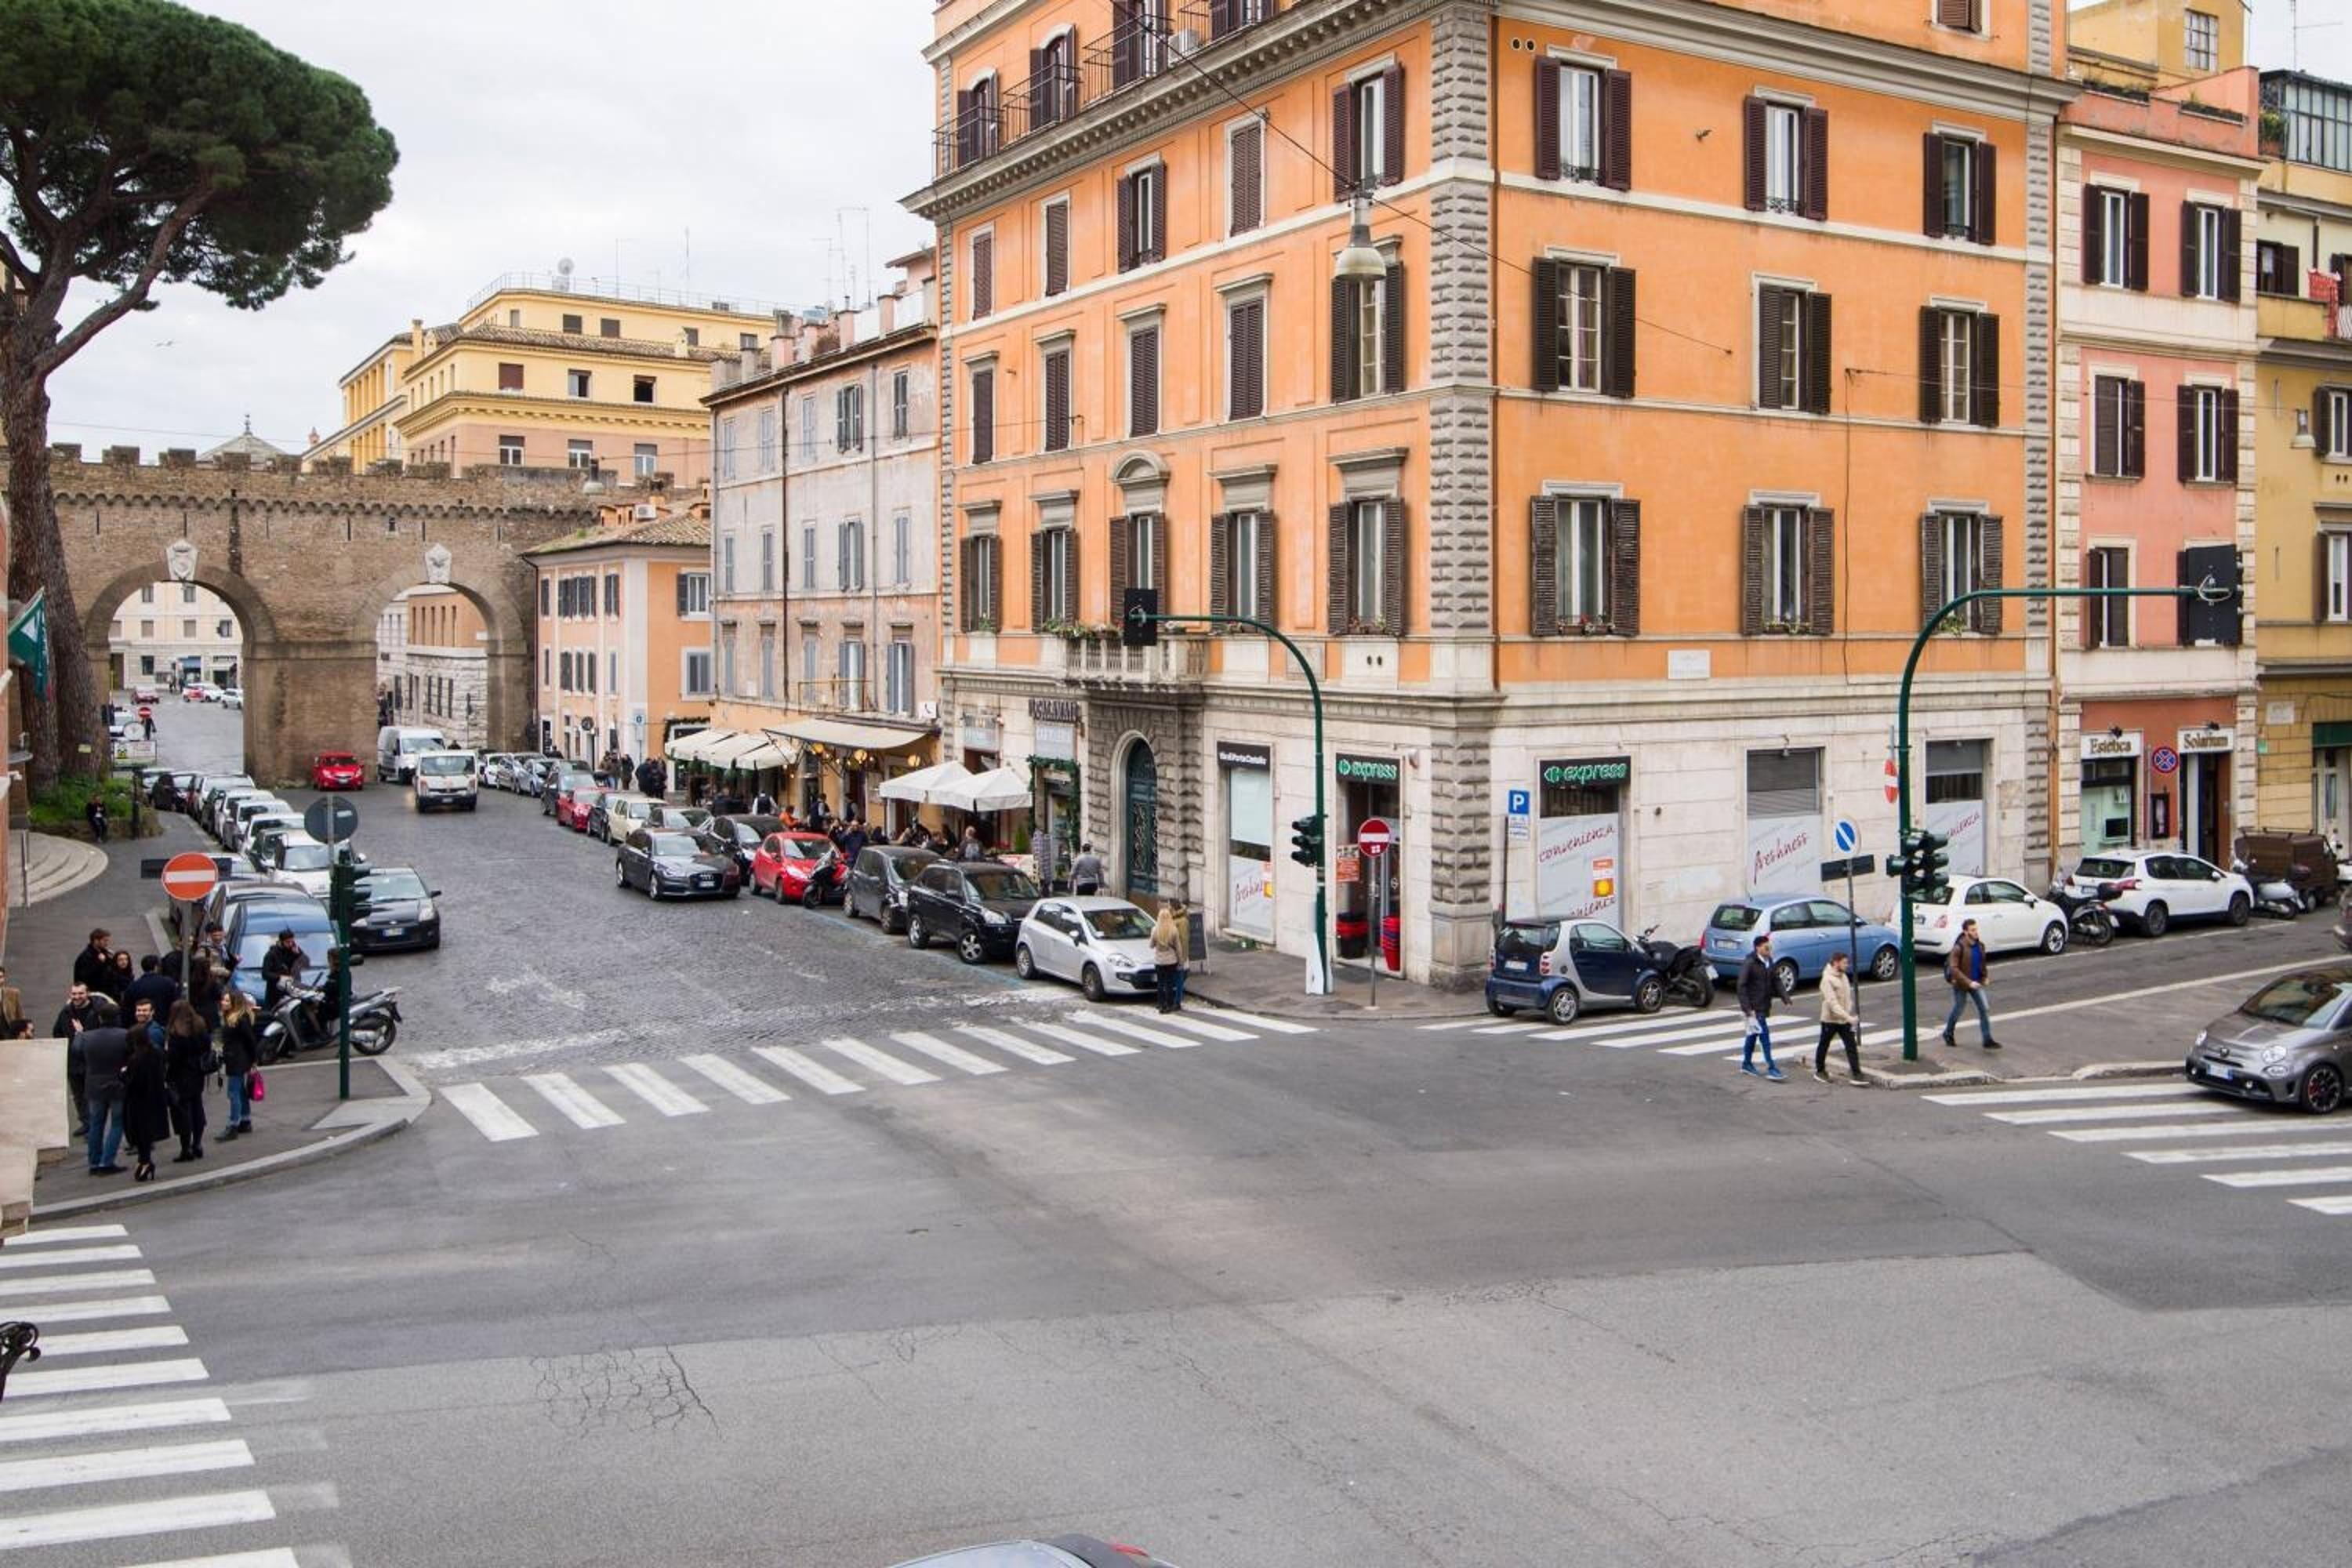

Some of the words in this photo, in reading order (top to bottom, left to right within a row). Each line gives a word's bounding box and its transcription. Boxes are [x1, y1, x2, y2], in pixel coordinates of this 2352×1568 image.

[2089, 739, 2132, 754] Estetica
[2183, 732, 2229, 749] Solarium
[1352, 760, 1398, 782] express
[1563, 763, 1627, 785] express
[1513, 793, 1525, 811] P
[1754, 831, 1807, 885] freshness
